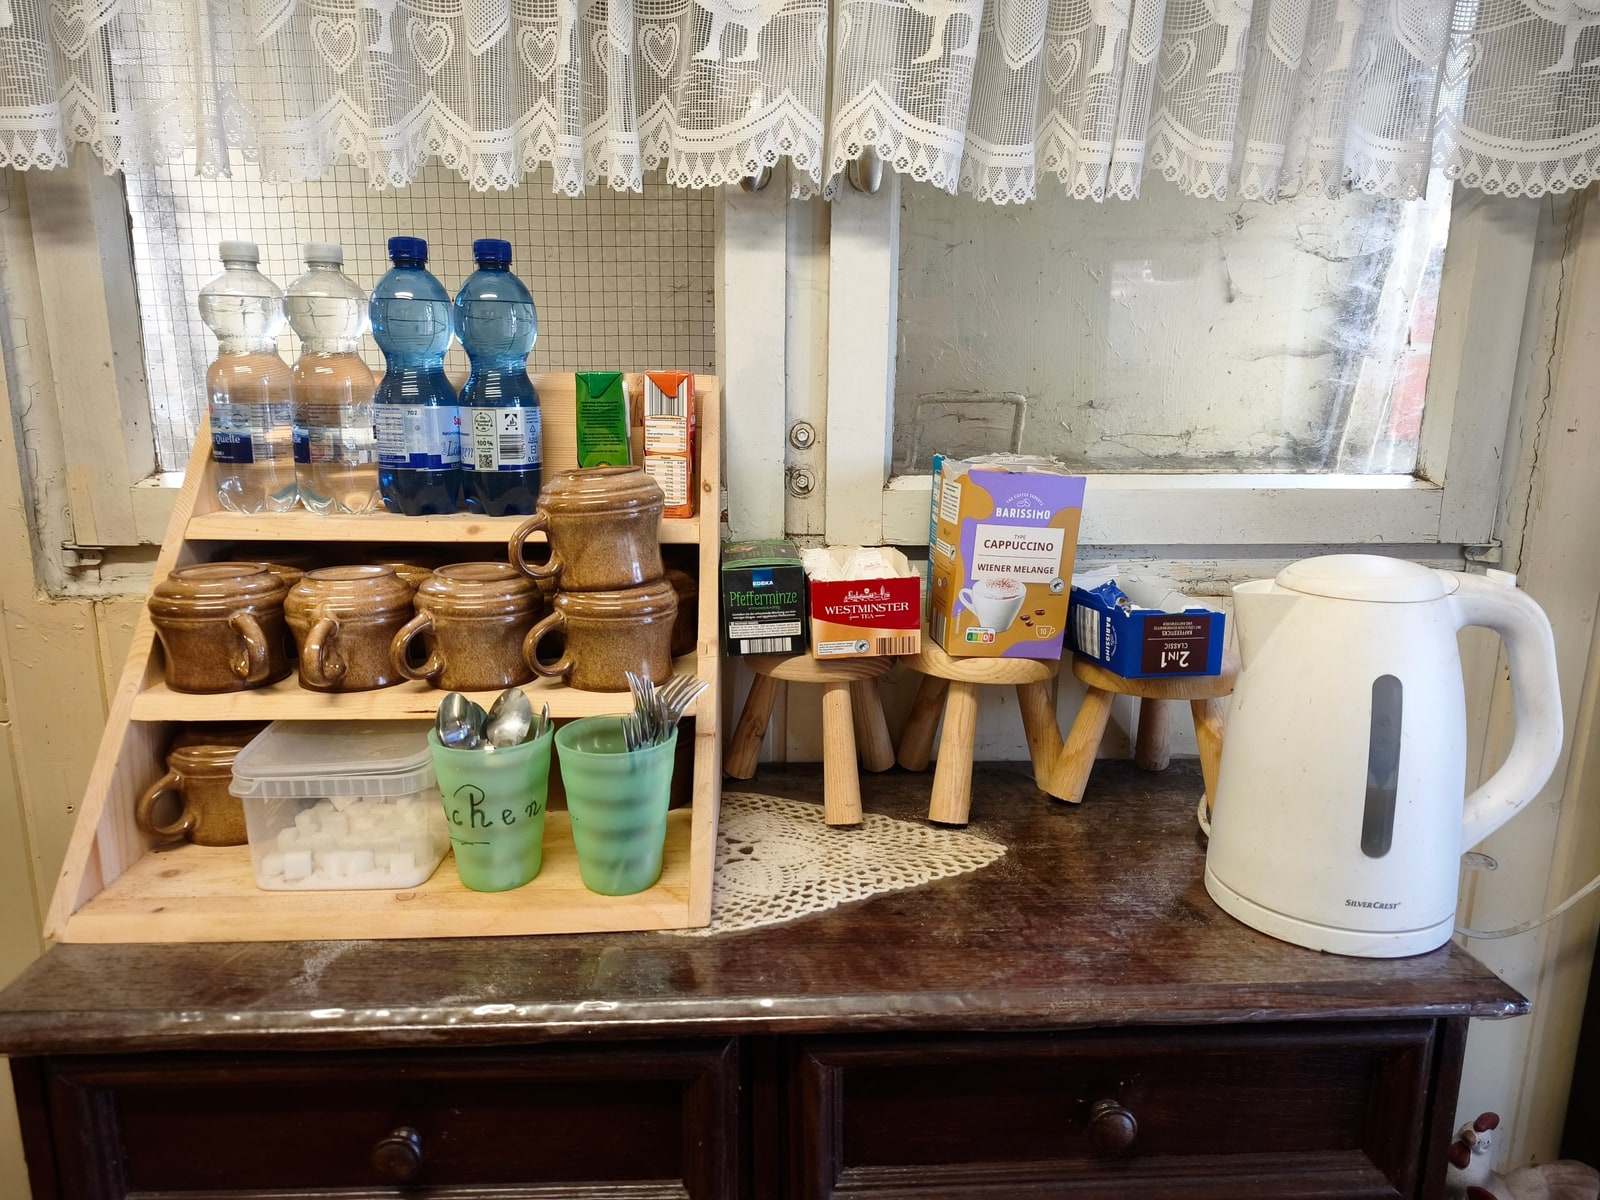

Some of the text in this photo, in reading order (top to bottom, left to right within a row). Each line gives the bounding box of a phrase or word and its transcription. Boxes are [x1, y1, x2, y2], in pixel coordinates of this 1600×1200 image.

[995, 507, 1051, 520] BARISSIMO
[983, 539, 1054, 552] CAPPUCCINO
[977, 563, 1055, 575] WIENER MELANGE
[729, 591, 798, 607] Pfefferminze
[824, 602, 909, 615] WESTMINSTER
[1105, 616, 1113, 662] BARISSIMO
[1163, 642, 1189, 650] CLASSIC
